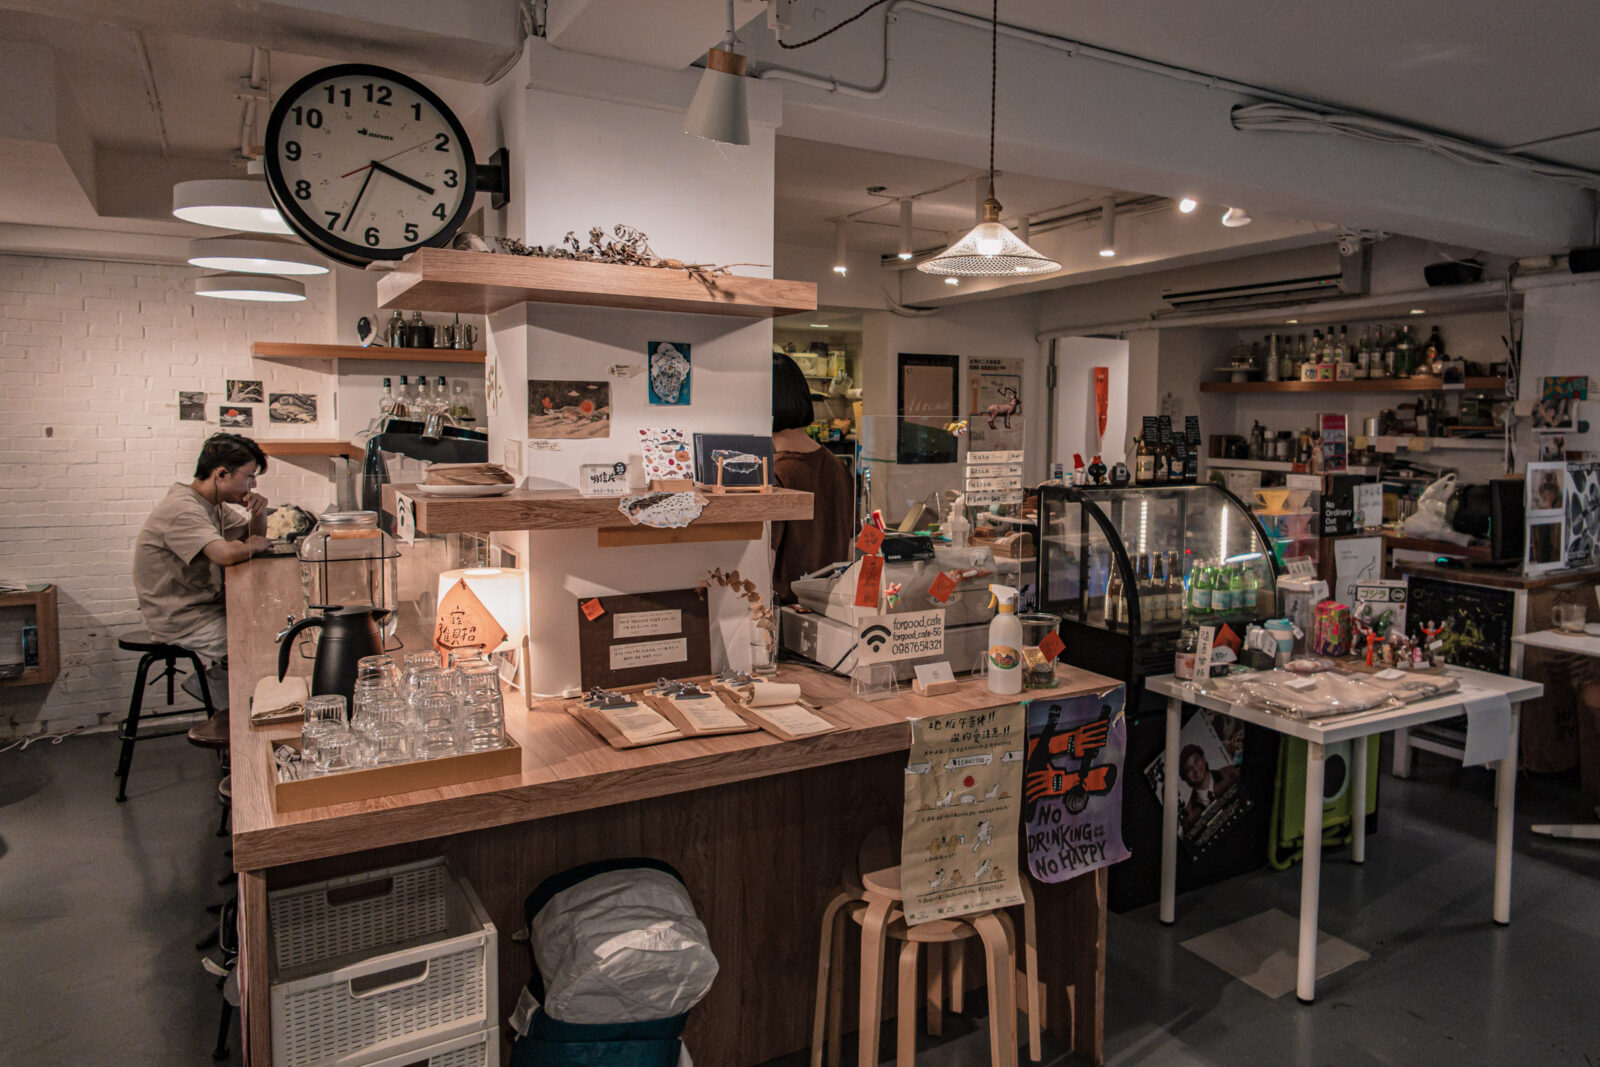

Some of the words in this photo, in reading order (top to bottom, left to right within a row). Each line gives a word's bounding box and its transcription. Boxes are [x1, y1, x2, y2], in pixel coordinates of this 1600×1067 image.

[324, 84, 351, 107] 11
[362, 84, 393, 106] 12
[291, 106, 323, 129] 10
[411, 103, 421, 121] 1
[285, 141, 302, 161] 9
[435, 133, 450, 152] 2
[443, 169, 458, 188] 3
[295, 180, 311, 200] 8
[324, 211, 341, 231] 7
[432, 203, 447, 221] 4
[364, 227, 380, 247] 6
[404, 223, 419, 242] 5
[590, 471, 616, 484] 明信片
[1325, 501, 1336, 509] No
[1325, 508, 1352, 518] Ordinary
[1359, 589, 1387, 599] ゴジラ
[892, 640, 942, 655] 0987654321
[1038, 804, 1062, 826] NO
[1035, 856, 1059, 878] NO
[1059, 841, 1107, 871] HAPPY
